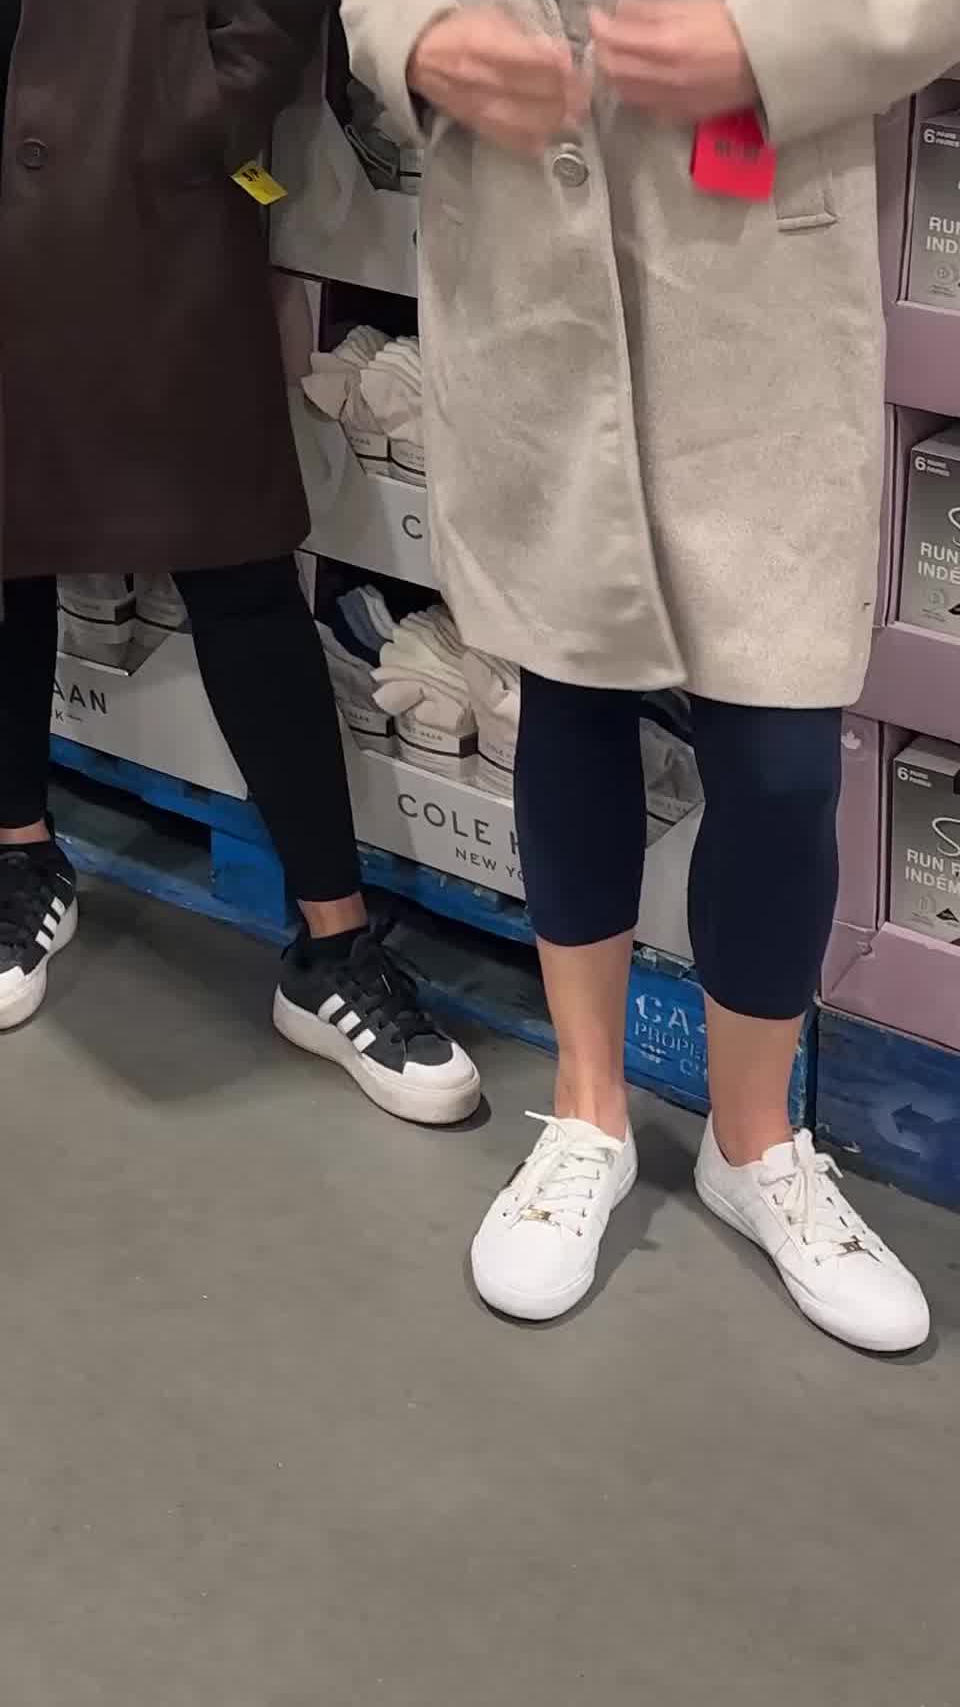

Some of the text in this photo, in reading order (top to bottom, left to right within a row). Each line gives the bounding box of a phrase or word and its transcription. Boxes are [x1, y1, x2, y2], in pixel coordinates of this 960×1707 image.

[923, 128, 936, 144] 6
[914, 456, 927, 472] 6
[896, 766, 909, 782] 6
[397, 793, 492, 846] COLE
[455, 846, 497, 871] NEW
[906, 848, 944, 871] RUN
[634, 1020, 707, 1065] PROPE
